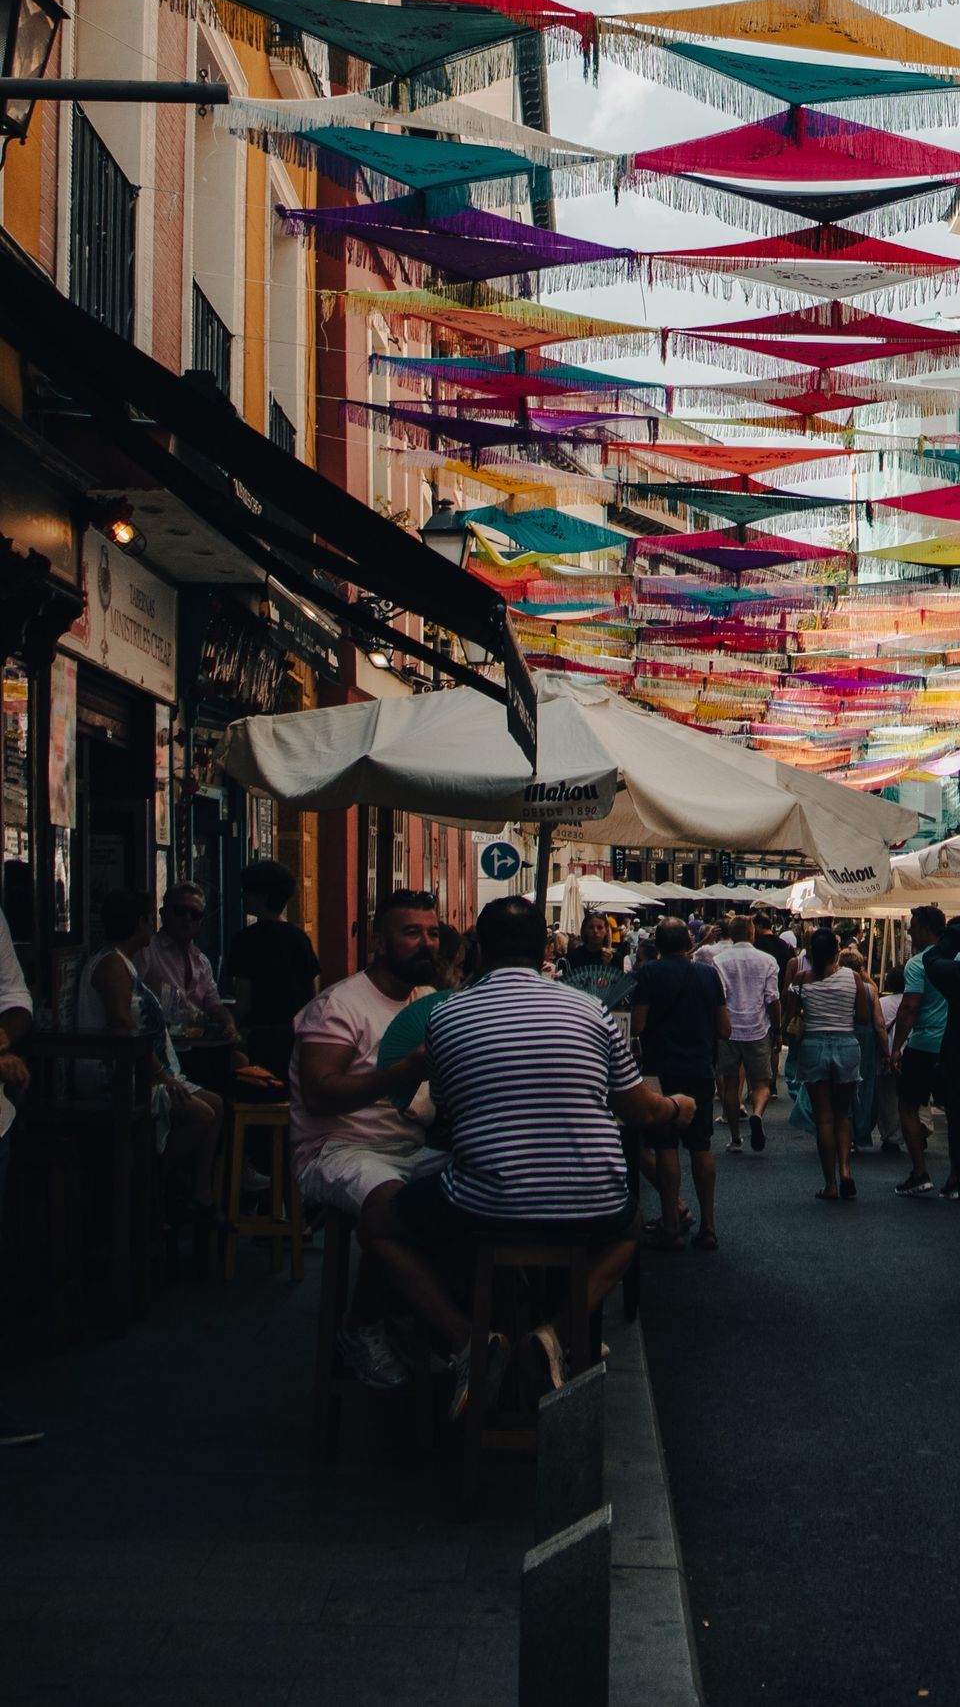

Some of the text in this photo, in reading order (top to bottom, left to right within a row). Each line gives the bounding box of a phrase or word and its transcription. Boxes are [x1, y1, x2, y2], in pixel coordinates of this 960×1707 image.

[524, 781, 599, 802] Mahou
[522, 806, 597, 818] DESDE 1890
[827, 866, 877, 884] Mahou
